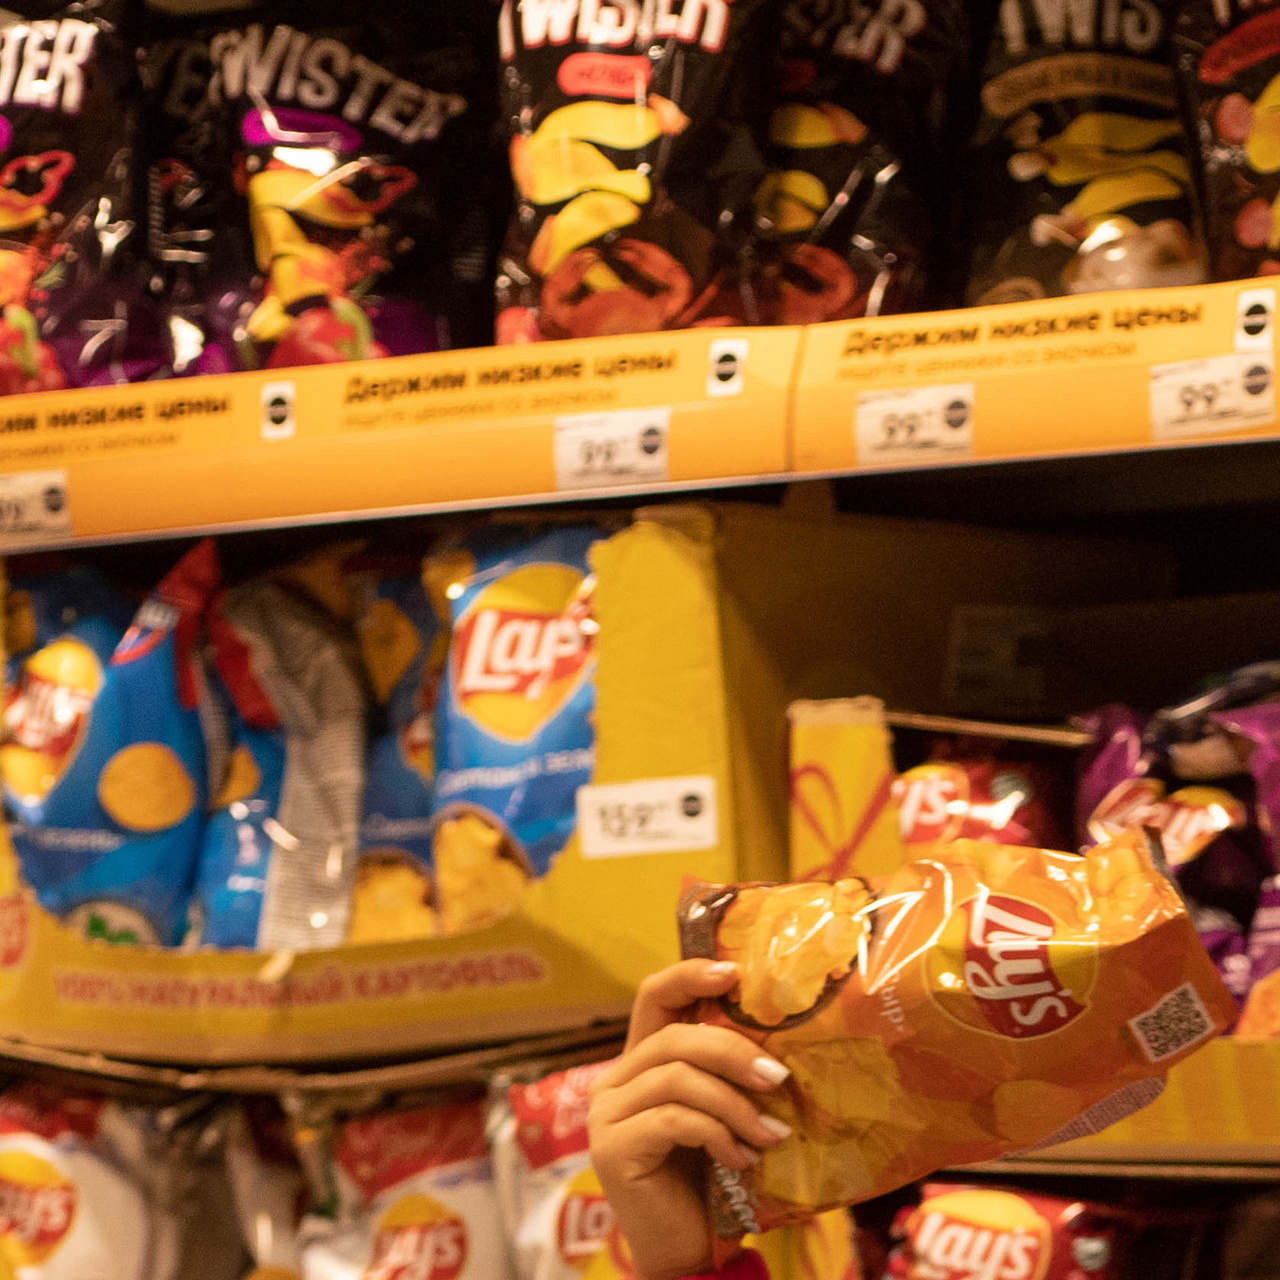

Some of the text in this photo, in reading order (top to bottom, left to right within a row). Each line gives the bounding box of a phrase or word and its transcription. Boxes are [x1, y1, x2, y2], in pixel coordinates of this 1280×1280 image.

[843, 303, 1204, 357] Держим низкие цены
[963, 901, 1069, 1028] Lay's
